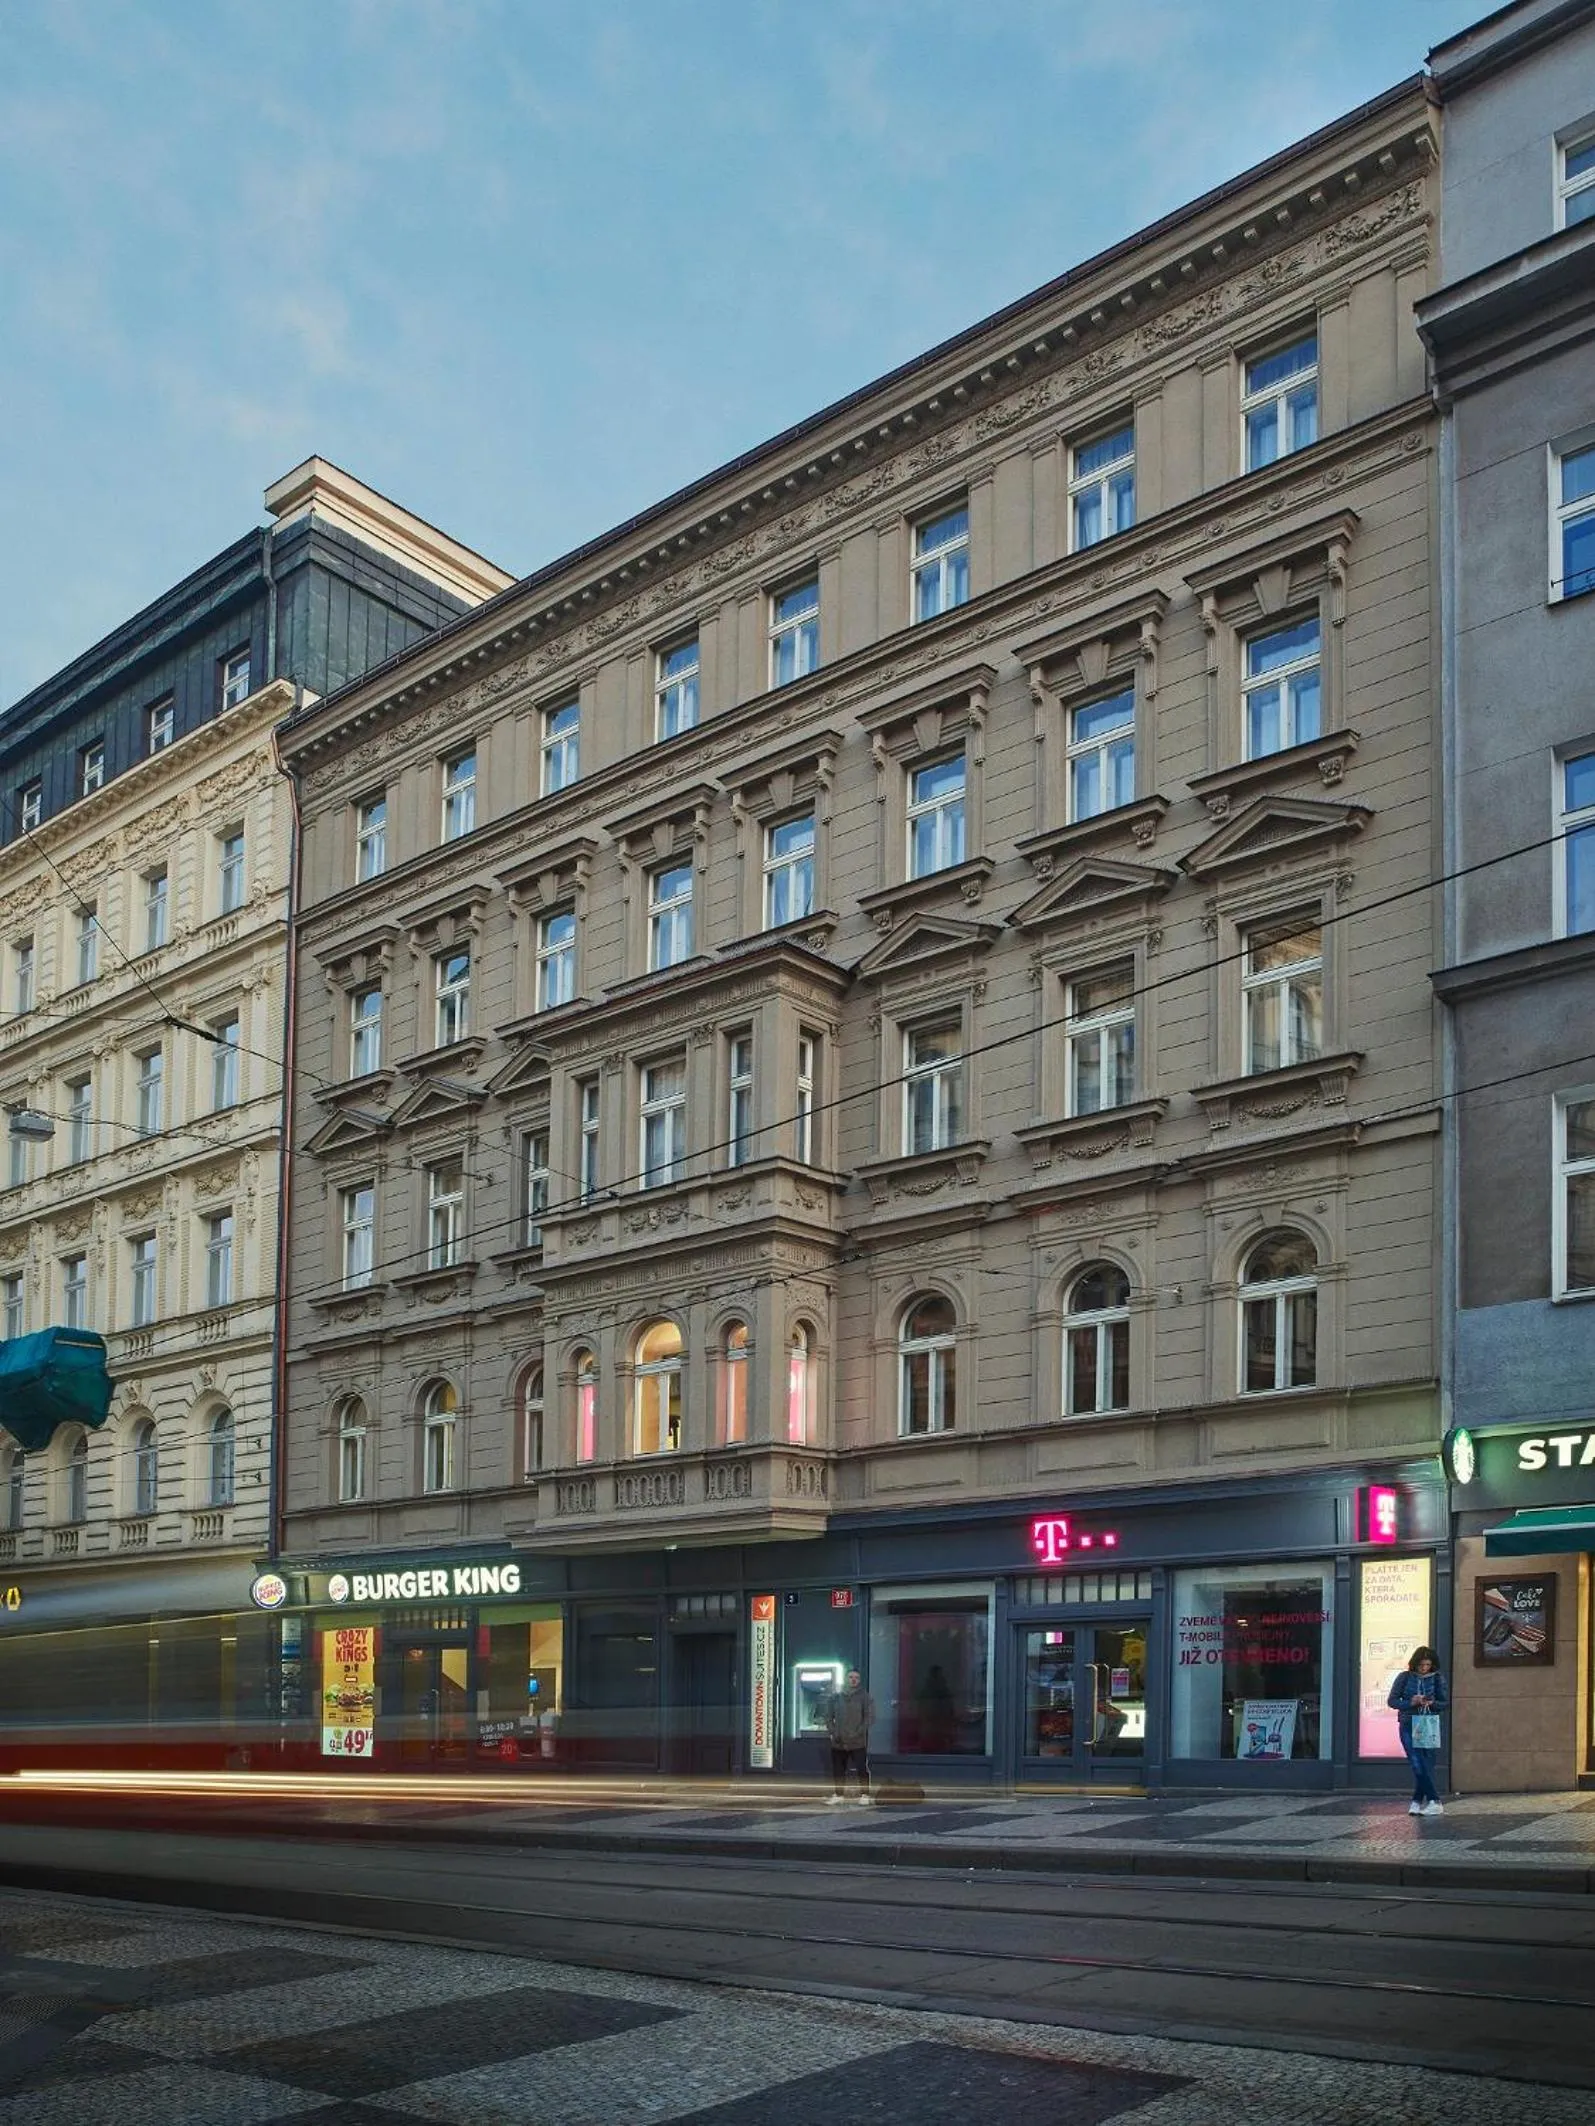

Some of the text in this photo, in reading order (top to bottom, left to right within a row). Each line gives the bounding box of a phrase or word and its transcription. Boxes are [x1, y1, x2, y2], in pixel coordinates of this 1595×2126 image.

[1377, 1494, 1395, 1535] T
[352, 1563, 521, 1601] BURGER KING
[1513, 1600, 1540, 1608] LOVE
[1179, 1614, 1218, 1627] ZVEME
[335, 1647, 368, 1662] KINGS
[1178, 1646, 1202, 1665] JIŽ
[343, 1730, 365, 1754] 49
